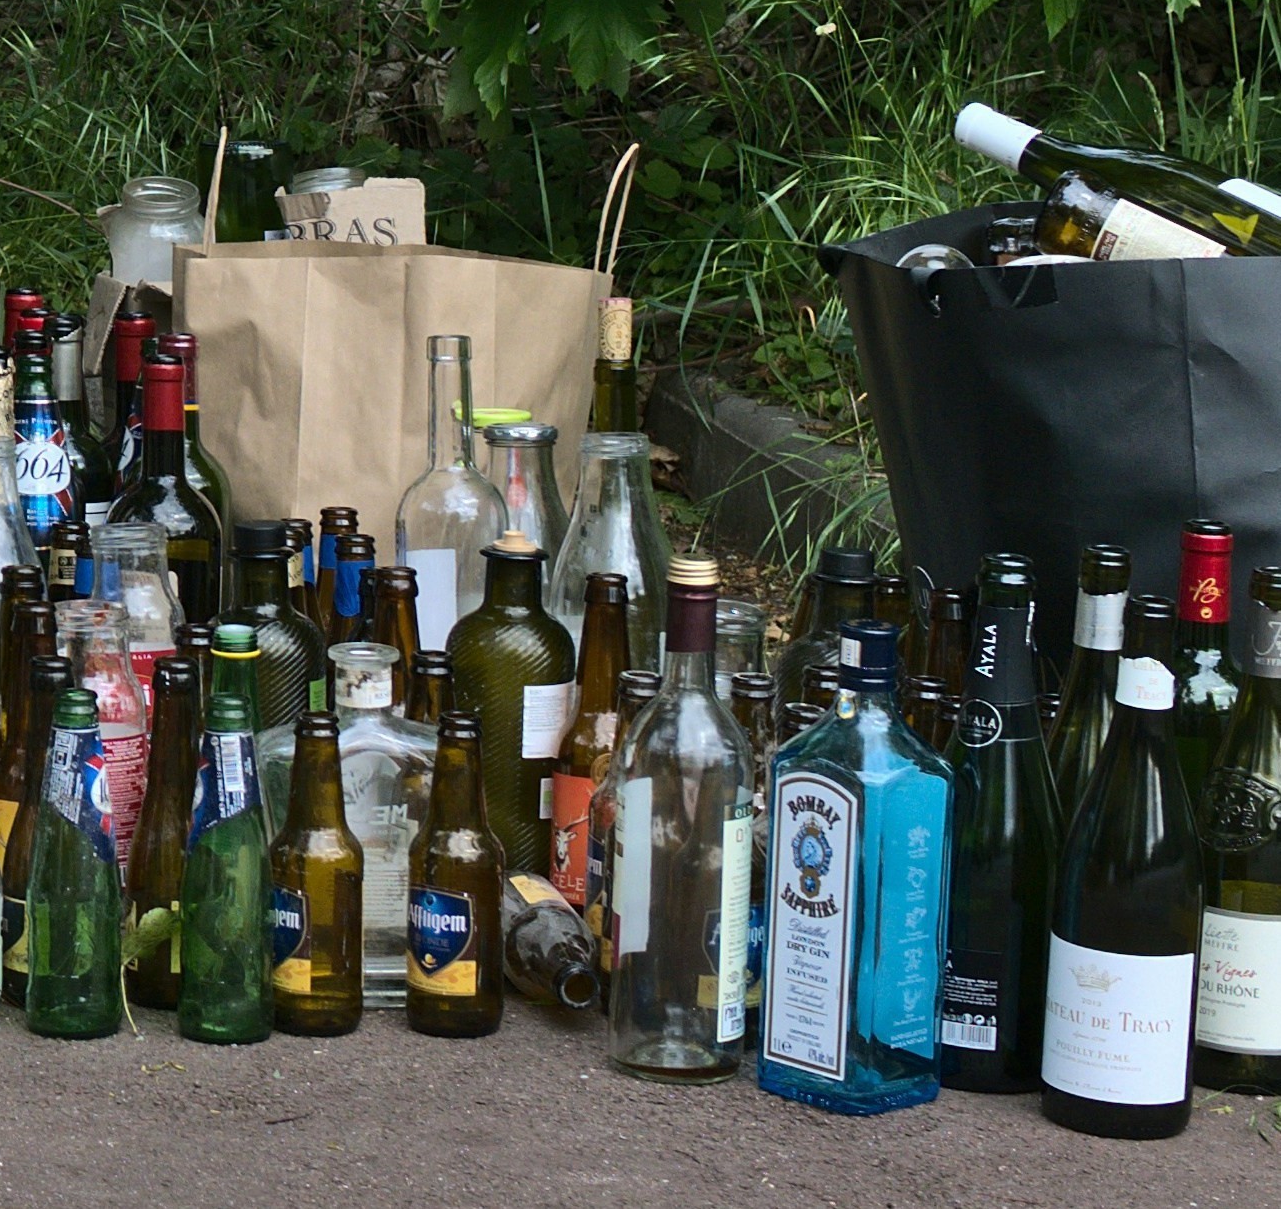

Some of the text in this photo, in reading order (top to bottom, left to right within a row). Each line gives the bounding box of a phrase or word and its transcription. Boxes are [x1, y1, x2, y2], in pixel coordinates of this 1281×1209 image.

[974, 623, 999, 679] AYALA
[787, 795, 841, 829] BOMBAY
[779, 882, 841, 919] SAPPHIRE
[786, 940, 830, 960] DRY GIN
[791, 933, 825, 948] LONDON
[786, 967, 828, 984] INFUSED
[1216, 983, 1260, 999] RHÔNE
[1091, 1011, 1174, 1034] DE TRACY
[1055, 1038, 1094, 1059] POUILLY
